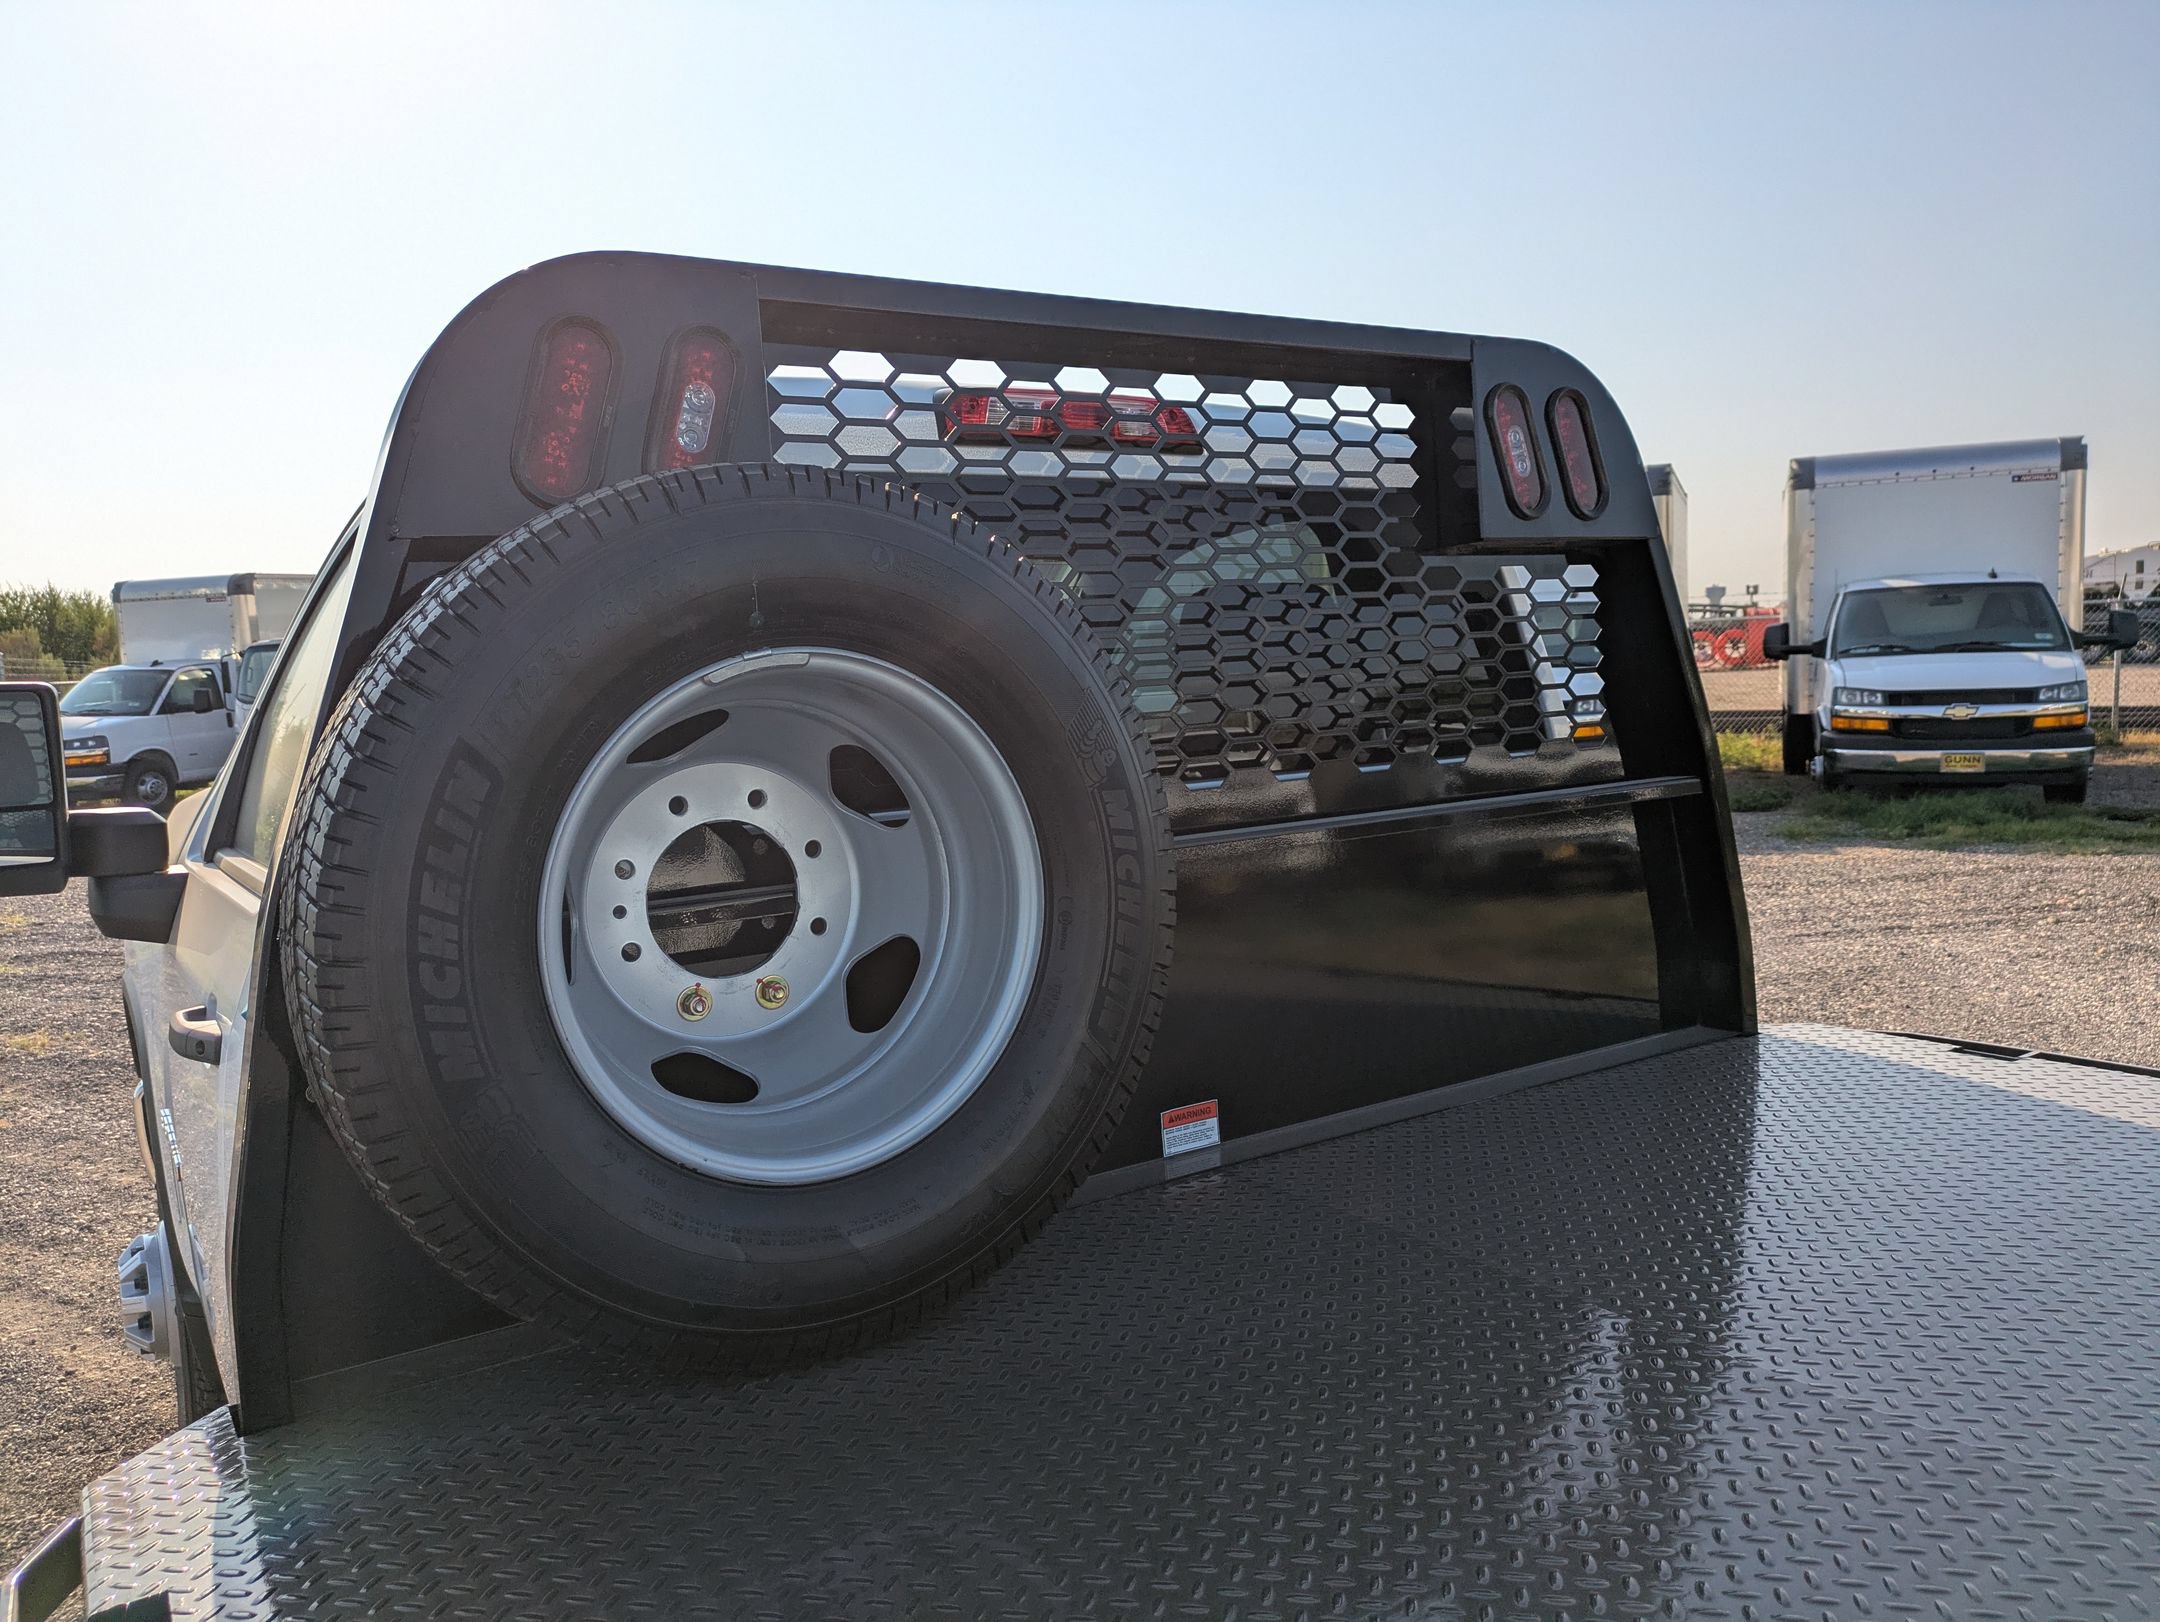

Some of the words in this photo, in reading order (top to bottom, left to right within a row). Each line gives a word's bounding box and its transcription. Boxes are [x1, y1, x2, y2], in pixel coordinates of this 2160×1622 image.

[1944, 755, 1981, 764] GUNN
[417, 758, 492, 1083] MICHELIN
[1098, 789, 1145, 1060] MICHELIN
[1174, 1106, 1212, 1122] WARNING
